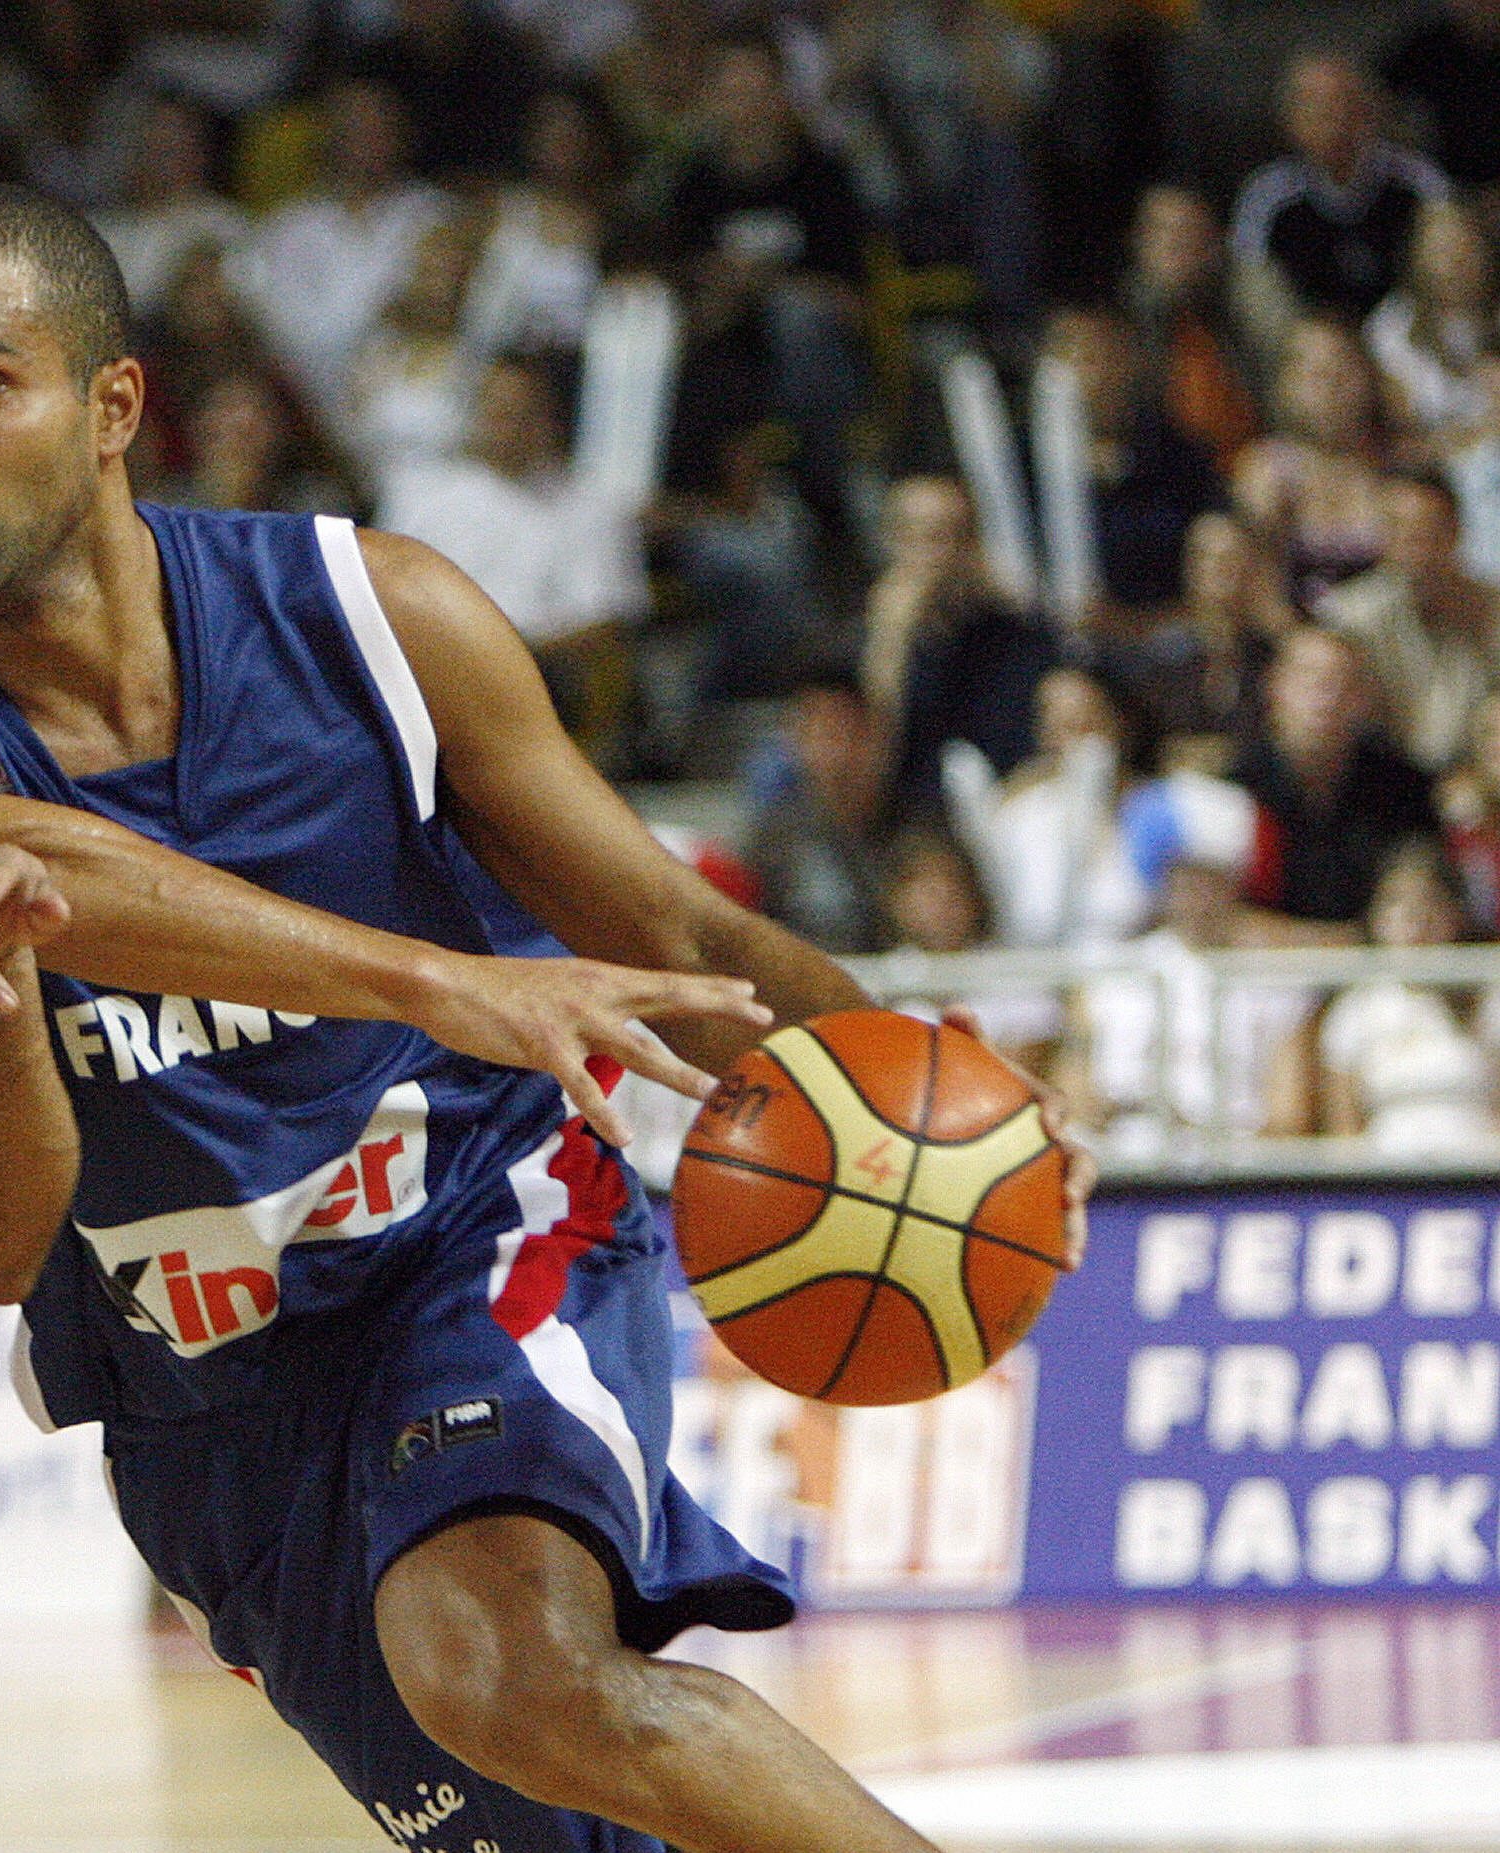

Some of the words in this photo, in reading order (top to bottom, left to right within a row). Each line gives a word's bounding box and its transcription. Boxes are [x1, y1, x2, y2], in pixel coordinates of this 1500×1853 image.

[853, 1137, 898, 1187] 4
[1135, 1210, 1500, 1322] FEDE
[1124, 1341, 1500, 1454] FRAN
[1114, 1474, 1496, 1588] BASK
